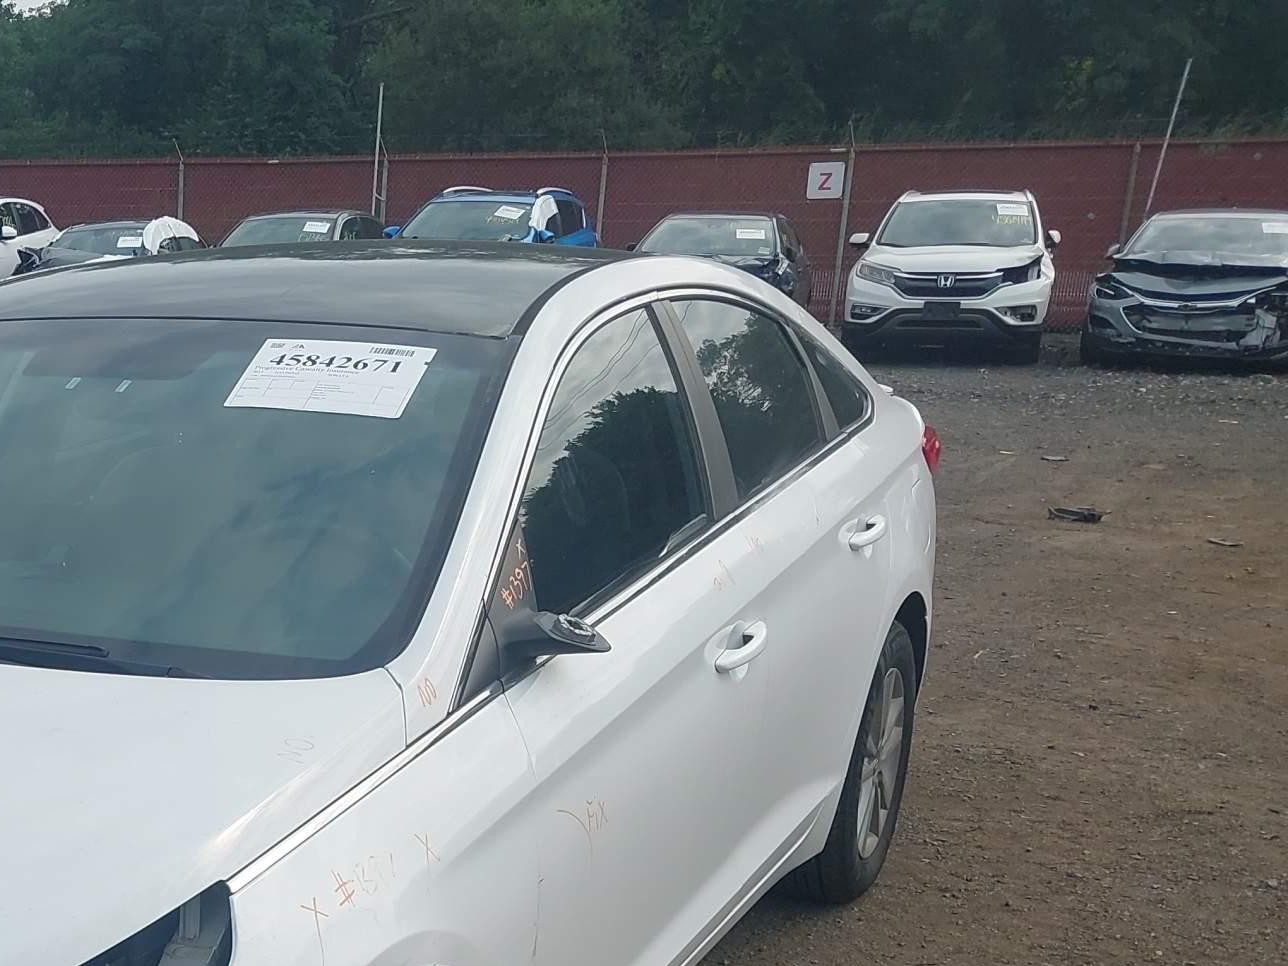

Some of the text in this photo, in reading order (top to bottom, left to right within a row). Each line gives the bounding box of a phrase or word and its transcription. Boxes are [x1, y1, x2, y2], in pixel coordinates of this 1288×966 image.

[817, 172, 833, 191] Z
[269, 353, 403, 373] 45842671
[500, 561, 533, 609] #1397
